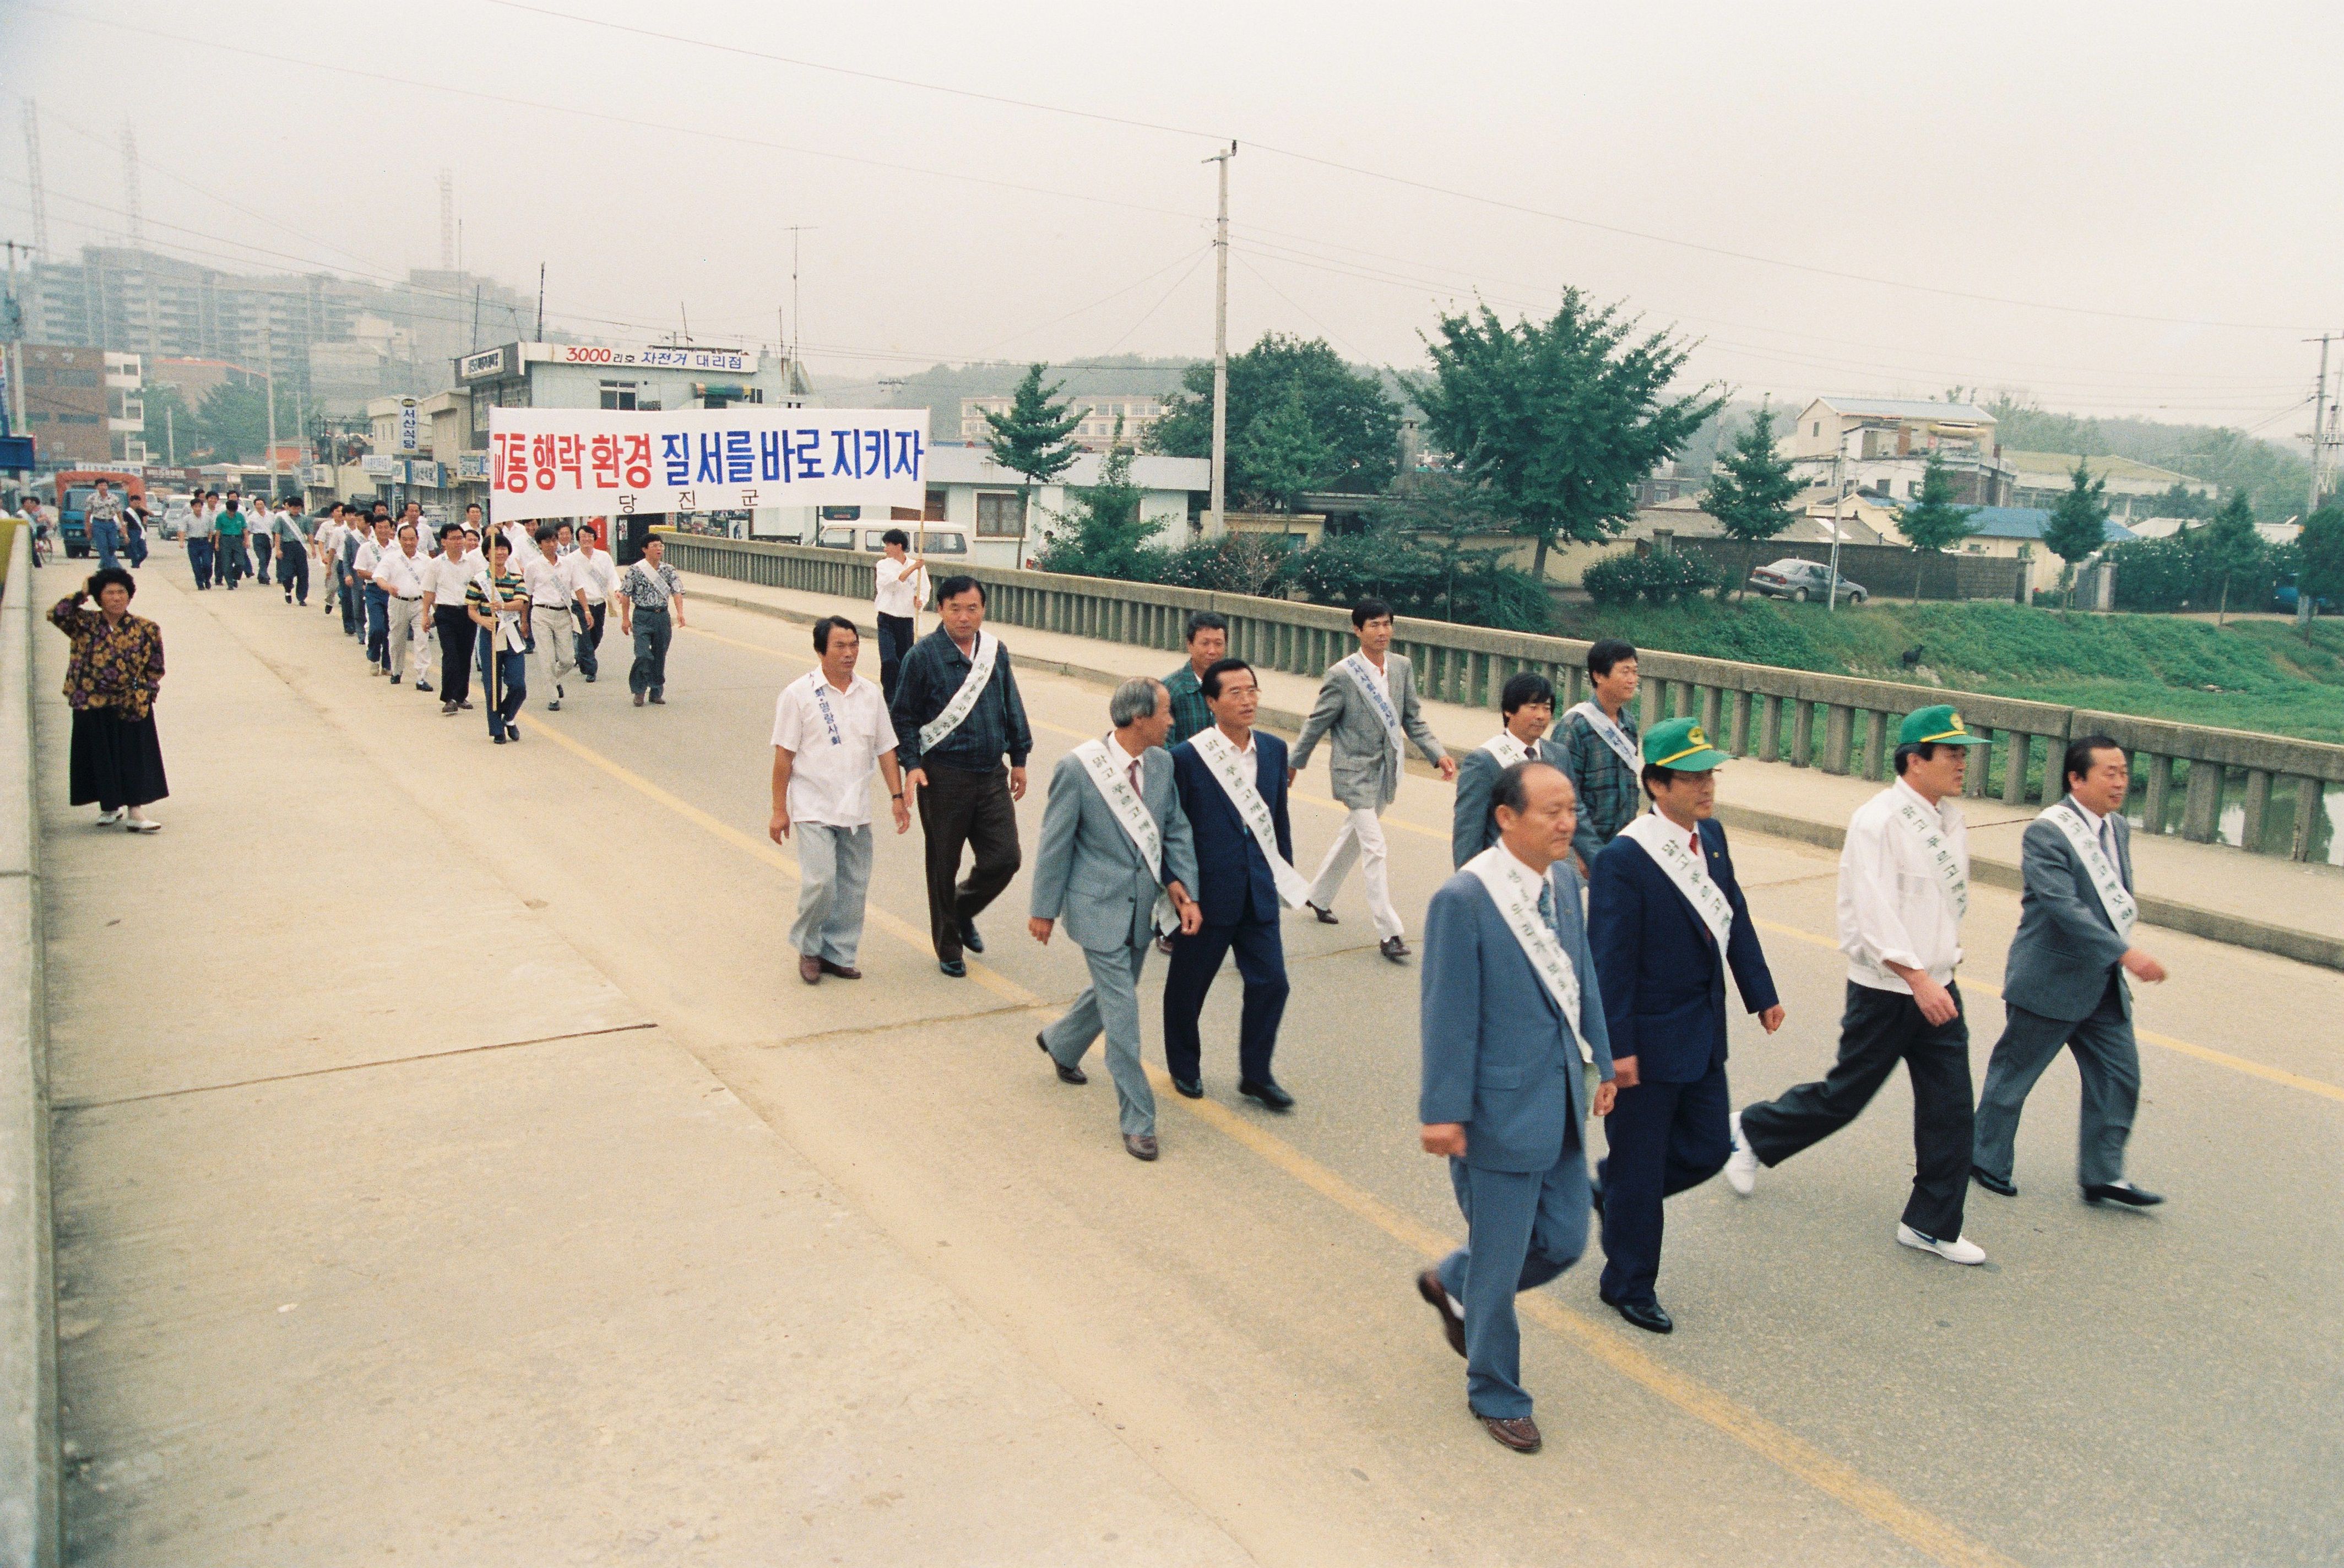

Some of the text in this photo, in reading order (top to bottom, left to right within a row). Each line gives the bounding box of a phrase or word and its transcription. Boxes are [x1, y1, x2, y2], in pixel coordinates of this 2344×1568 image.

[641, 351, 688, 366] 자전거
[695, 354, 742, 369] 대리점
[404, 409, 416, 449] 서산식당
